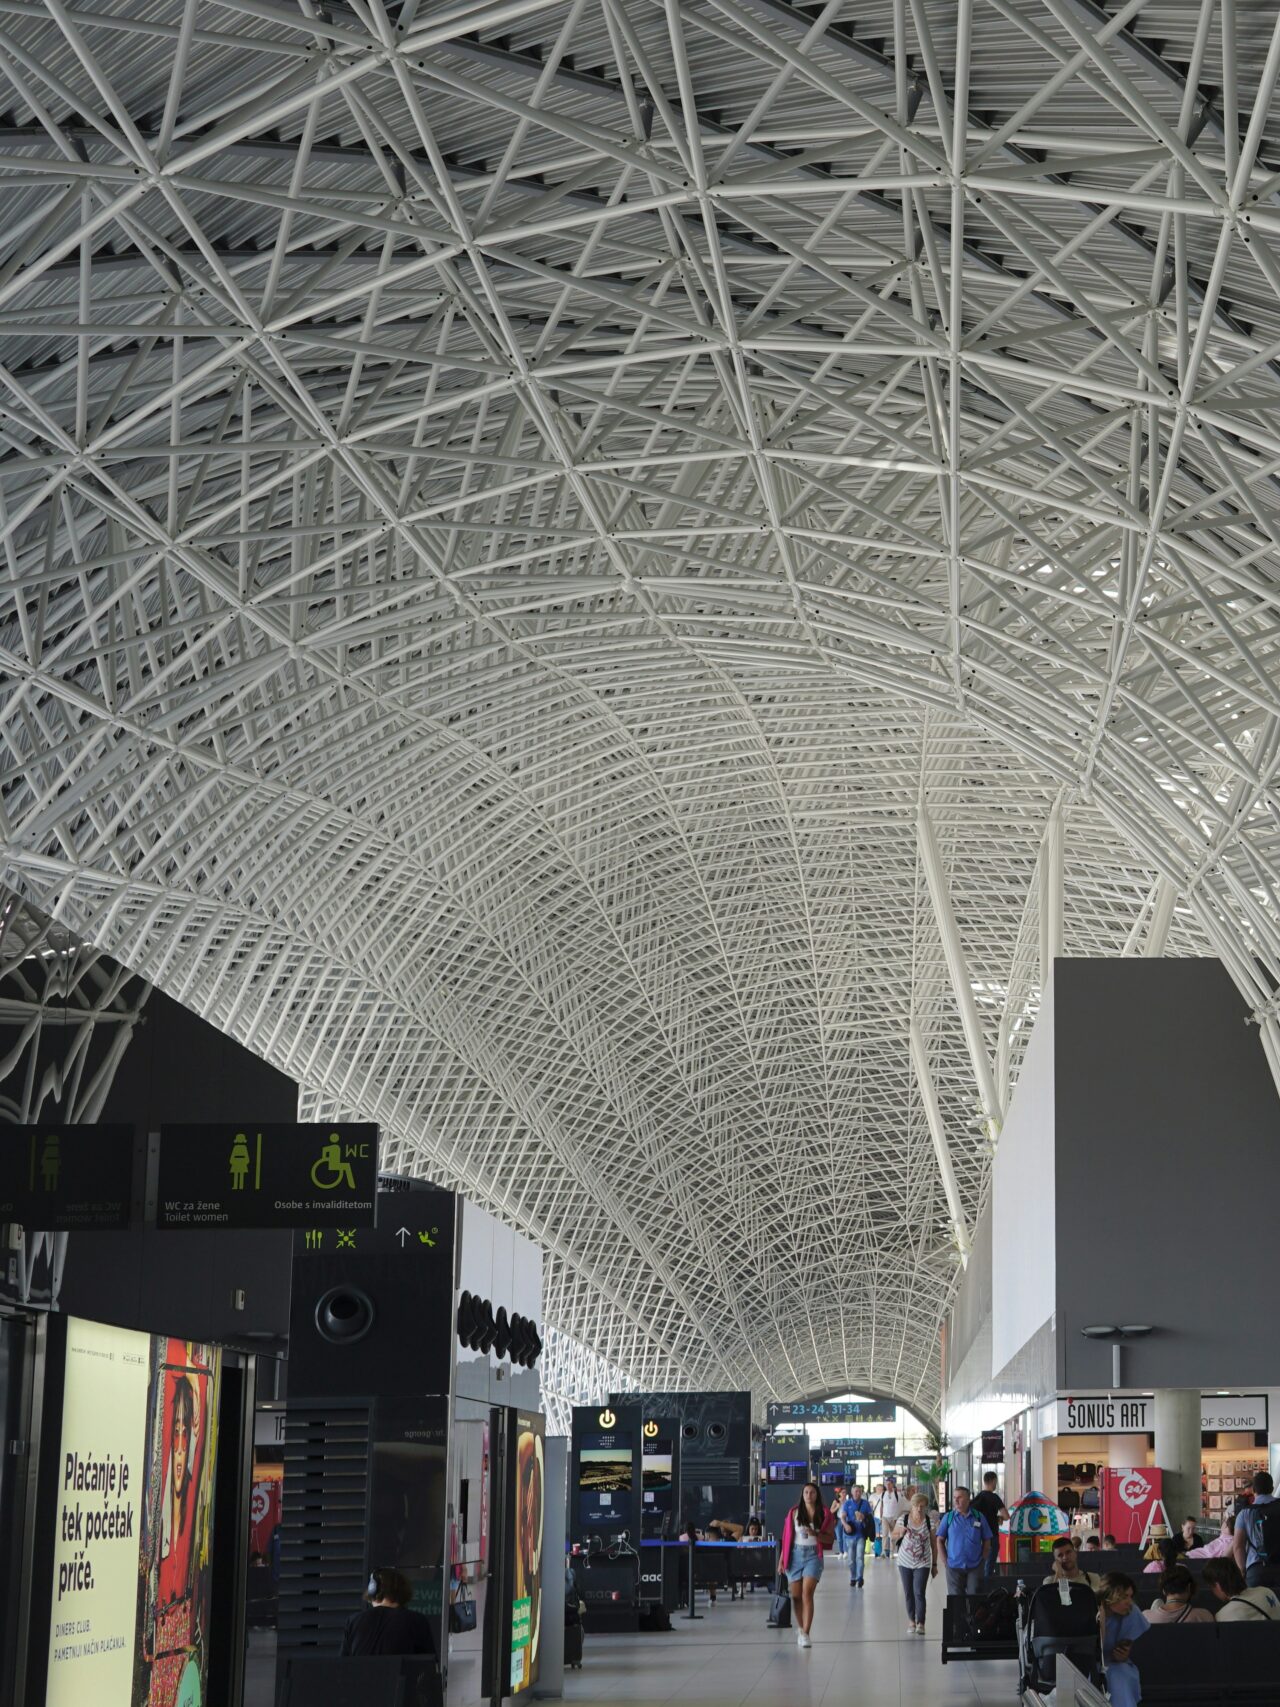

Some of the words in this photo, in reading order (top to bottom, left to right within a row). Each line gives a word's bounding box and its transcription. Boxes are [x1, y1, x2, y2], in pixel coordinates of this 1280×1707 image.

[345, 1143, 369, 1158] WC
[165, 1202, 181, 1210] WC
[197, 1201, 220, 1210] žene
[274, 1200, 303, 1209] Osobe
[312, 1200, 372, 1209] invaliditetom
[165, 1212, 190, 1222] Toilet
[193, 1213, 229, 1222] women
[831, 1404, 860, 1414] 31-34
[1068, 1404, 1115, 1428] SONUS
[1121, 1403, 1147, 1427] ART
[1201, 1417, 1215, 1427] OF
[1218, 1416, 1256, 1427] SOUND
[64, 1451, 116, 1499] Plaćanje
[117, 1454, 129, 1499] je
[1126, 1484, 1152, 1494] 24/7
[62, 1502, 83, 1542] tek
[85, 1501, 134, 1549] početak
[58, 1551, 95, 1601] priče.
[55, 1621, 75, 1638] DINERS
[76, 1619, 91, 1634] CLUB.
[83, 1638, 99, 1656] NAČIN
